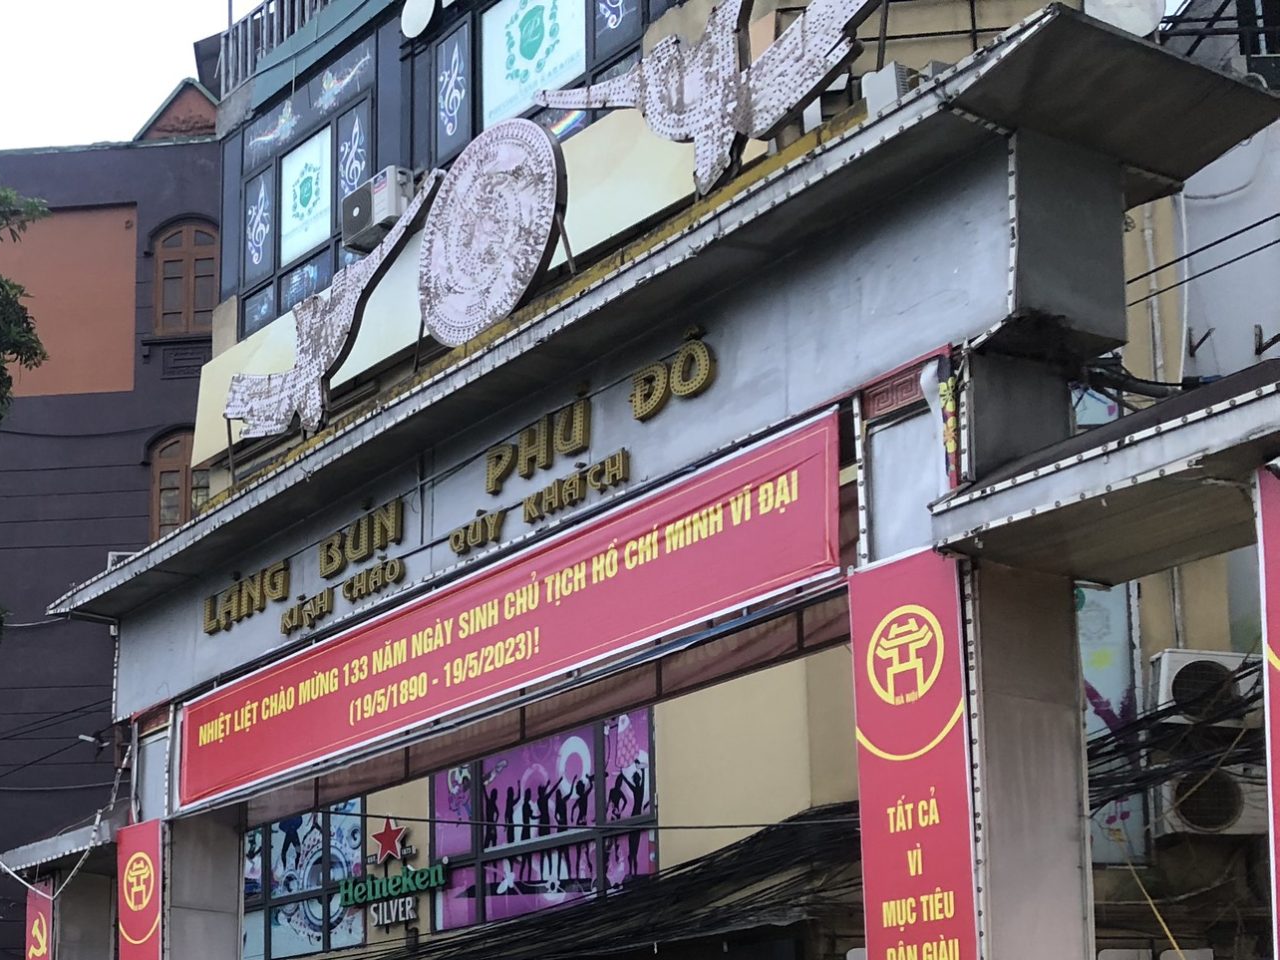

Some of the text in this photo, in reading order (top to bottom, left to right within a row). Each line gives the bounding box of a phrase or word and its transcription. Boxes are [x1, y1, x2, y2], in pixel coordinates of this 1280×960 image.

[198, 469, 799, 746] NHIỆT LIỆT CHÀO MỪNG 133 NĂM NGÀY SINH CHỦ TỊCH HỒ CHÍ MINH VĨ ĐẠI
[203, 559, 290, 635] LÀNG
[348, 671, 428, 726] (19/5/1890
[887, 787, 940, 834] TẤT CẢ
[907, 843, 923, 876] VÌ
[338, 864, 447, 907] Heineken
[370, 896, 417, 926] SILVER
[882, 887, 955, 932] MỤC TIÊU
